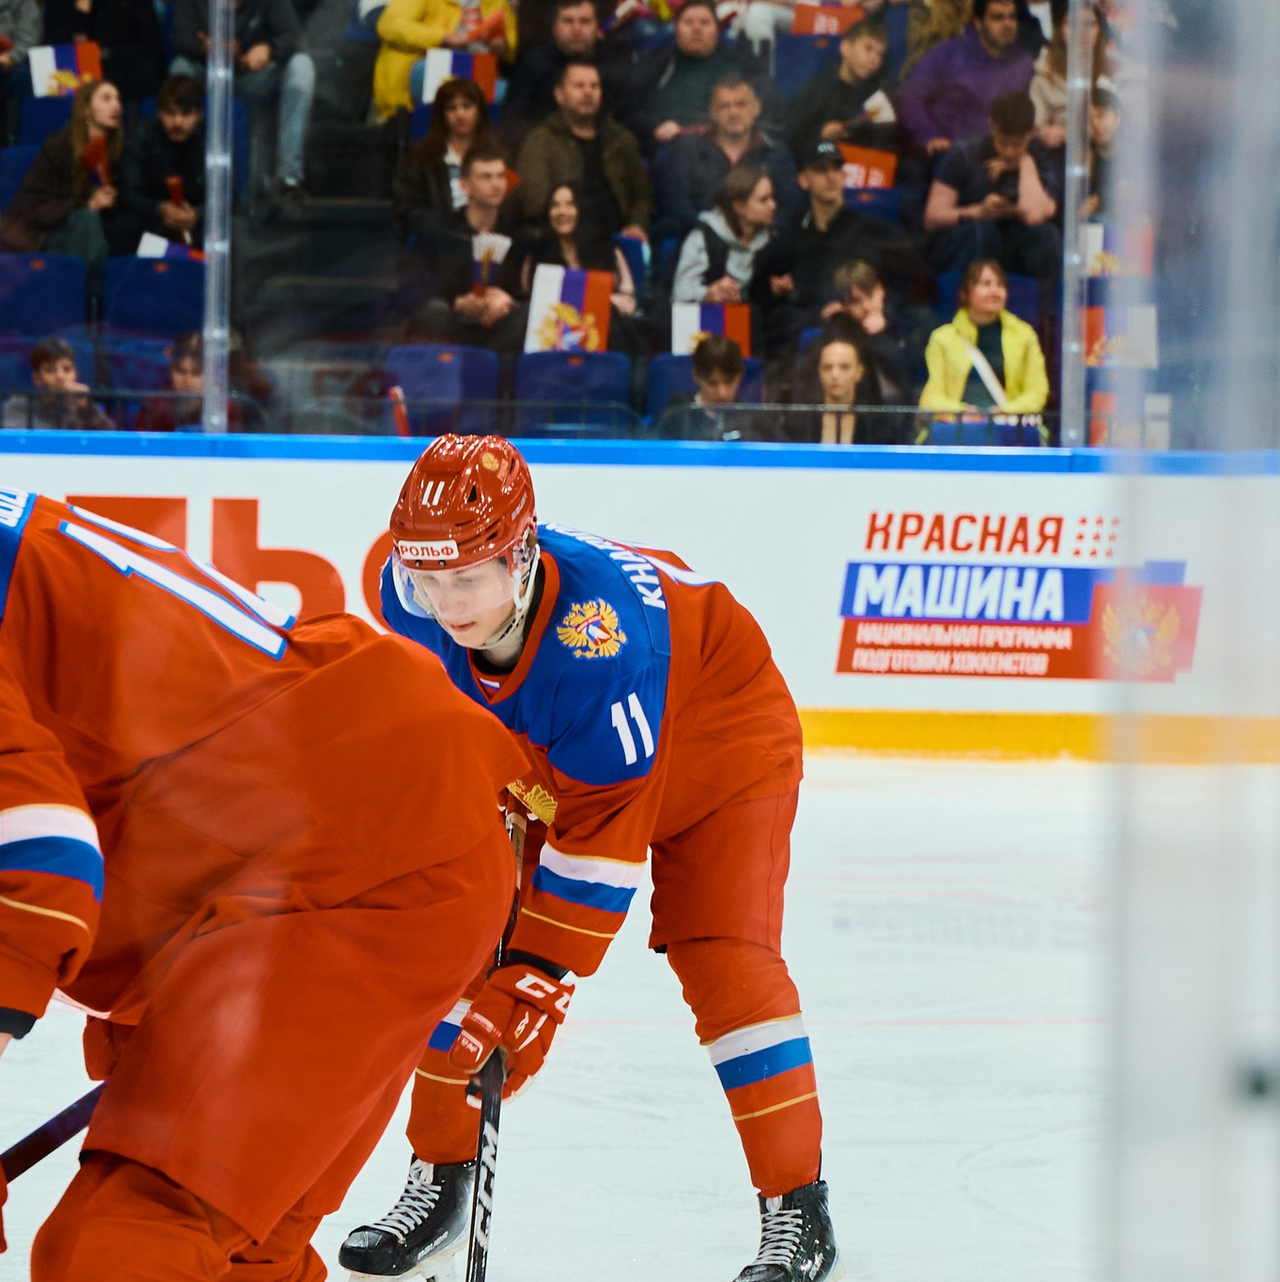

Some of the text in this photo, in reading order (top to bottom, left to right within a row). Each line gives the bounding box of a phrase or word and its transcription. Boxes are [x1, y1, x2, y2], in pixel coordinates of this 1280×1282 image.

[421, 480, 446, 506] 11
[400, 544, 455, 558] РОЛЬФ
[865, 511, 1064, 554] КРАСНАЯ
[852, 564, 1065, 622] МАШИНА
[611, 692, 655, 766] 11
[475, 1120, 499, 1251] CCM
